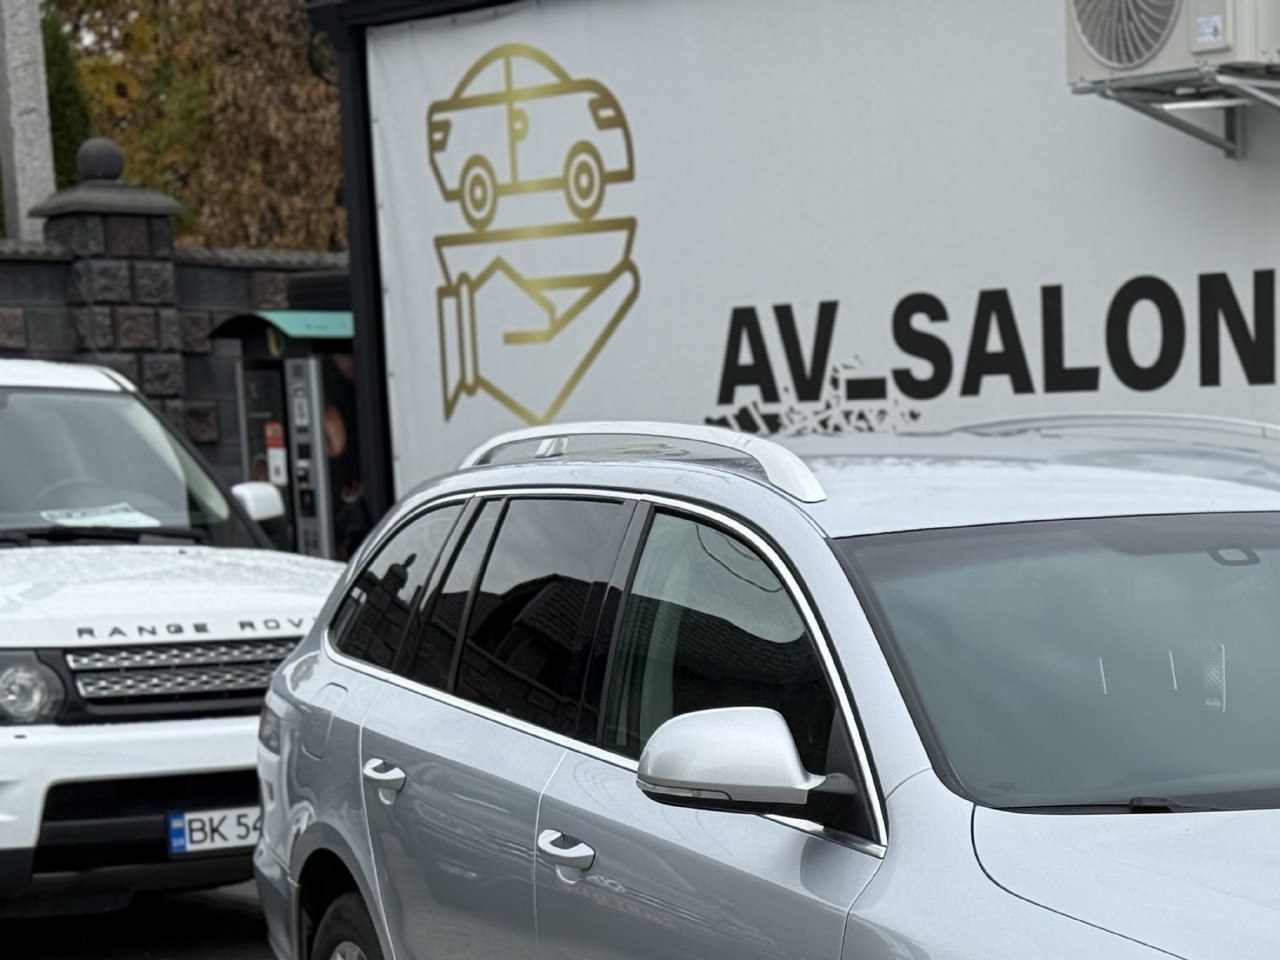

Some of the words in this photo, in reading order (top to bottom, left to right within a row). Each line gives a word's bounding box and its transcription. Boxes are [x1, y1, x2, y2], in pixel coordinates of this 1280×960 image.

[76, 622, 209, 638] RANGE
[238, 617, 317, 632] ROV
[188, 815, 229, 845] BK
